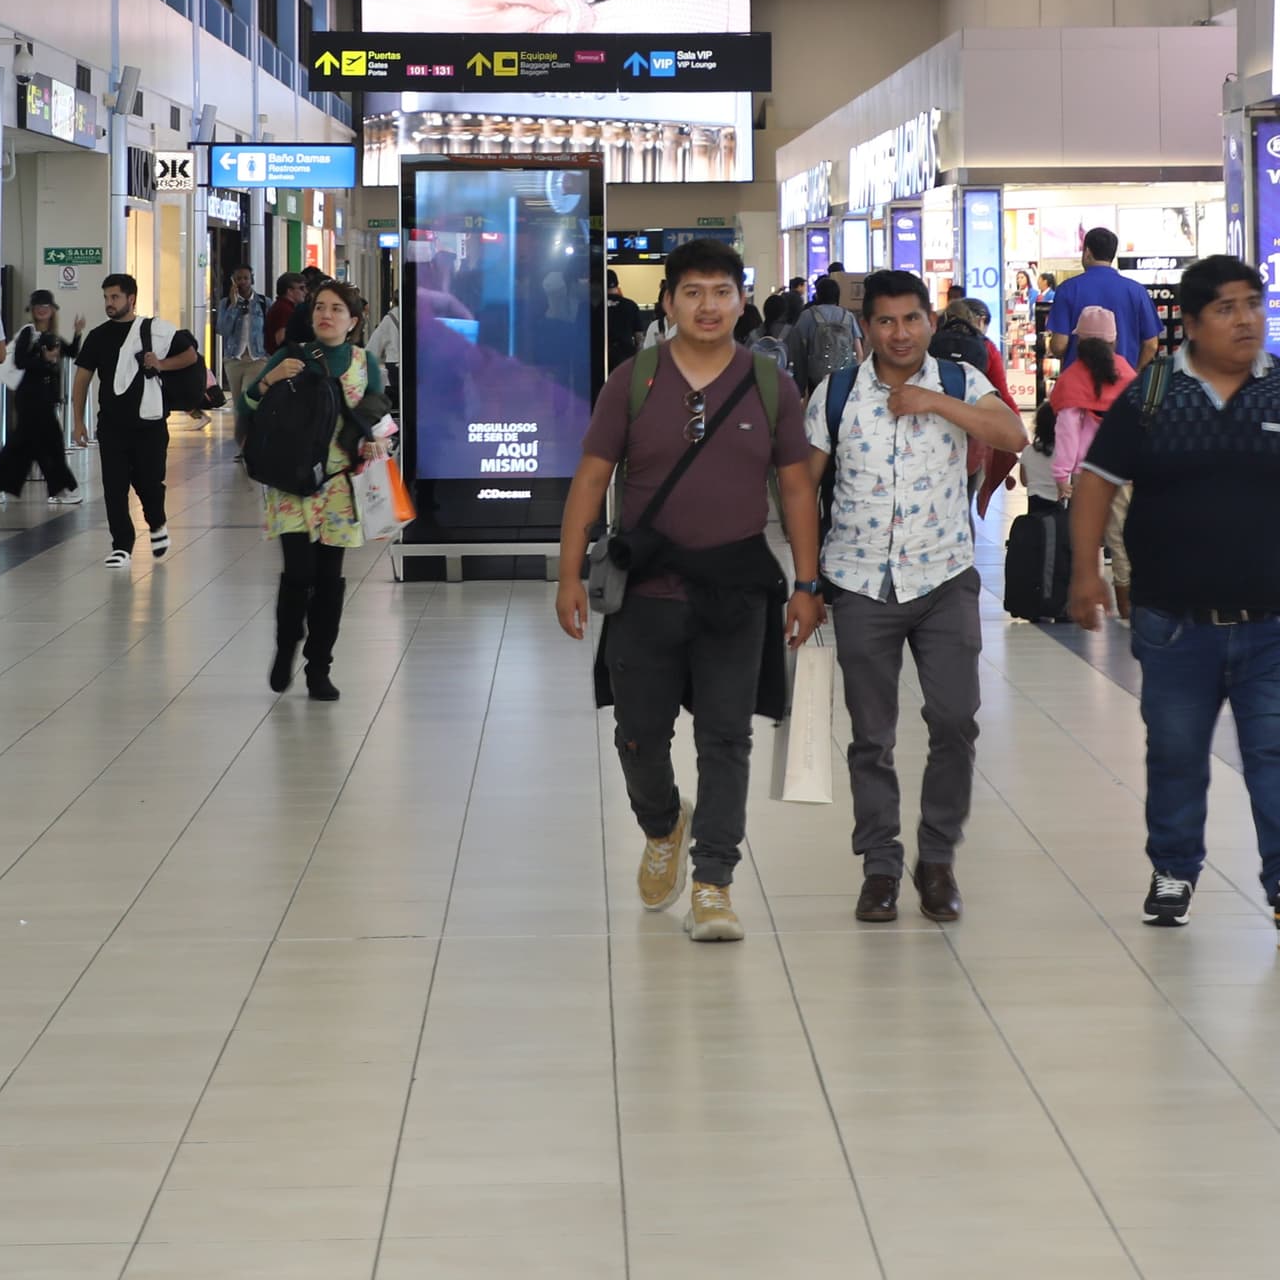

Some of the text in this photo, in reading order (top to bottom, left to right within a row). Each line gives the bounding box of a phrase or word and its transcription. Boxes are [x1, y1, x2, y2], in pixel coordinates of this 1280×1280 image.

[368, 51, 401, 61] Puertas
[520, 51, 558, 61] Equipaje
[677, 51, 713, 61] Sala VIP
[368, 62, 388, 70] Gates
[652, 59, 673, 69] VIP
[677, 61, 717, 70] VIP Lounge
[410, 67, 425, 75] 101
[435, 67, 451, 75] 131
[268, 152, 331, 164] Baño Damas
[268, 165, 311, 173] Restrooms
[1269, 299, 1280, 308] DE
[1009, 384, 1035, 396] $99
[468, 422, 538, 433] ORGULLOSOS
[468, 432, 519, 442] DE SER DE
[496, 440, 539, 458] AQUÍ
[480, 458, 538, 473] MISMO
[477, 488, 532, 499] JCDecaux
